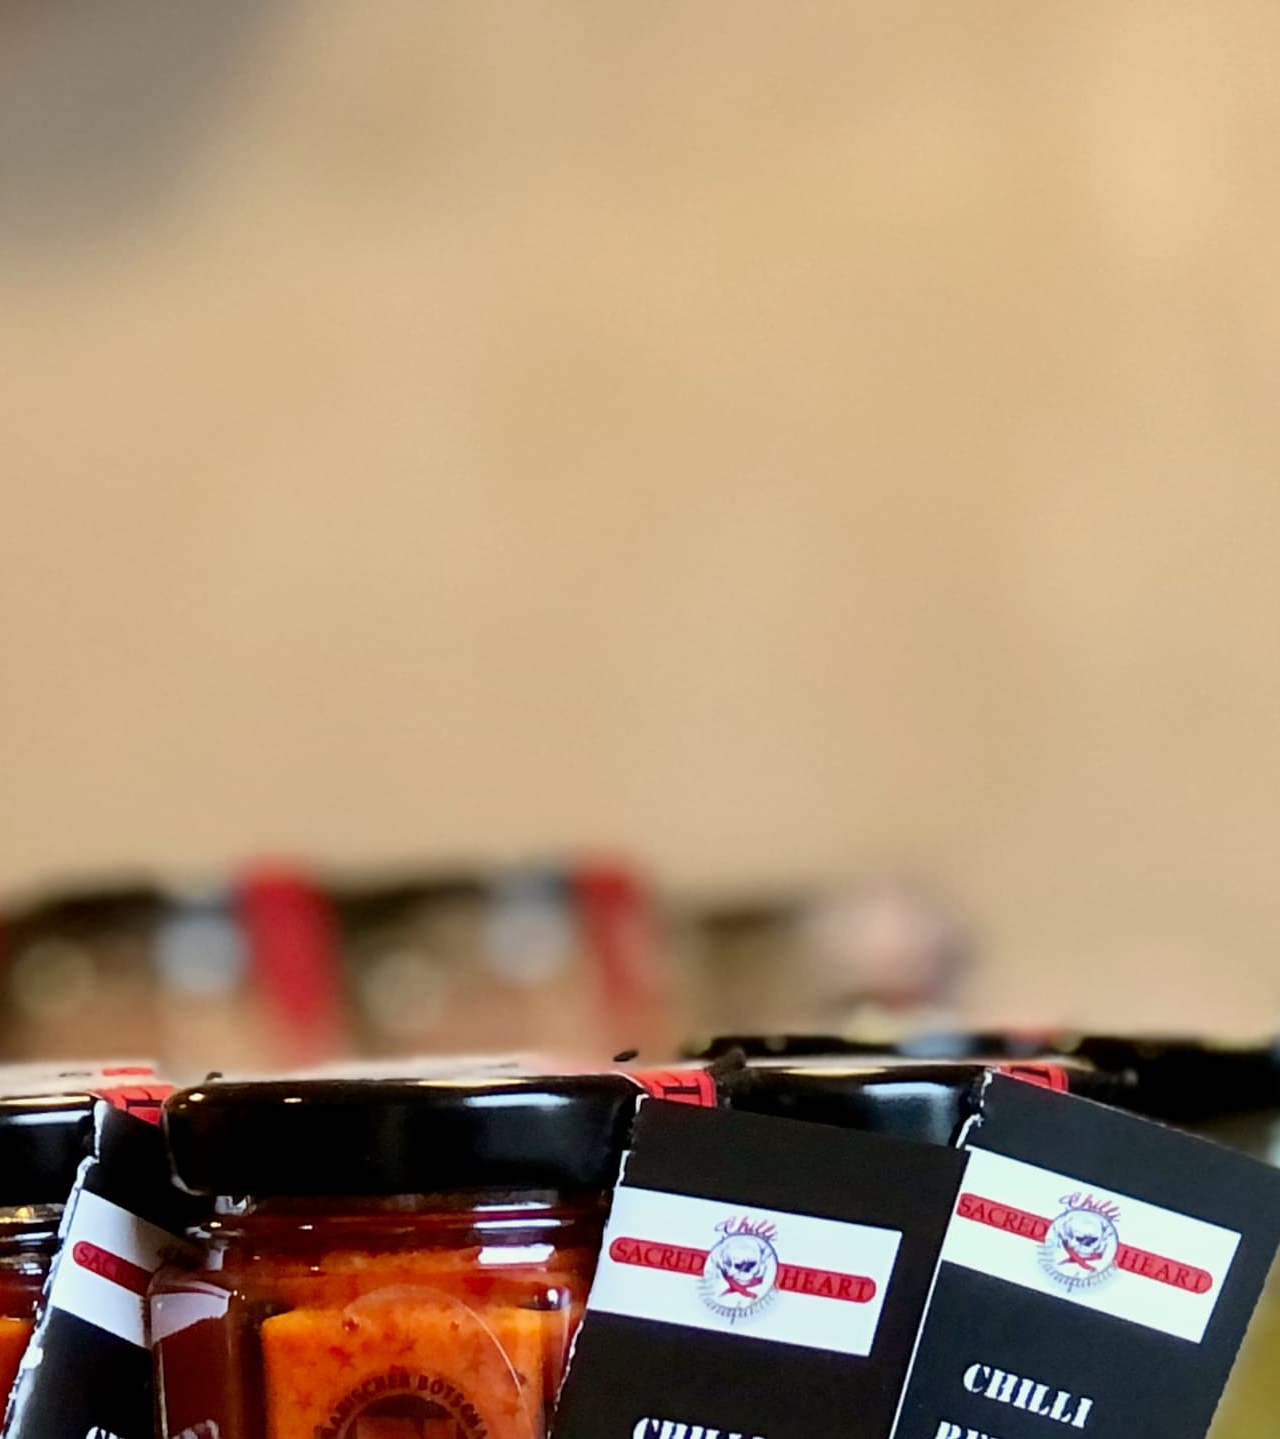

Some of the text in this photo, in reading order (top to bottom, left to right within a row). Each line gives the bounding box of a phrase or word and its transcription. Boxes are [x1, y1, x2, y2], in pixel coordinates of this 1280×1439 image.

[614, 1241, 870, 1300] SACRED HEART
[958, 1198, 1207, 1291] SACRED HEART
[963, 1363, 1094, 1429] CHILLI
